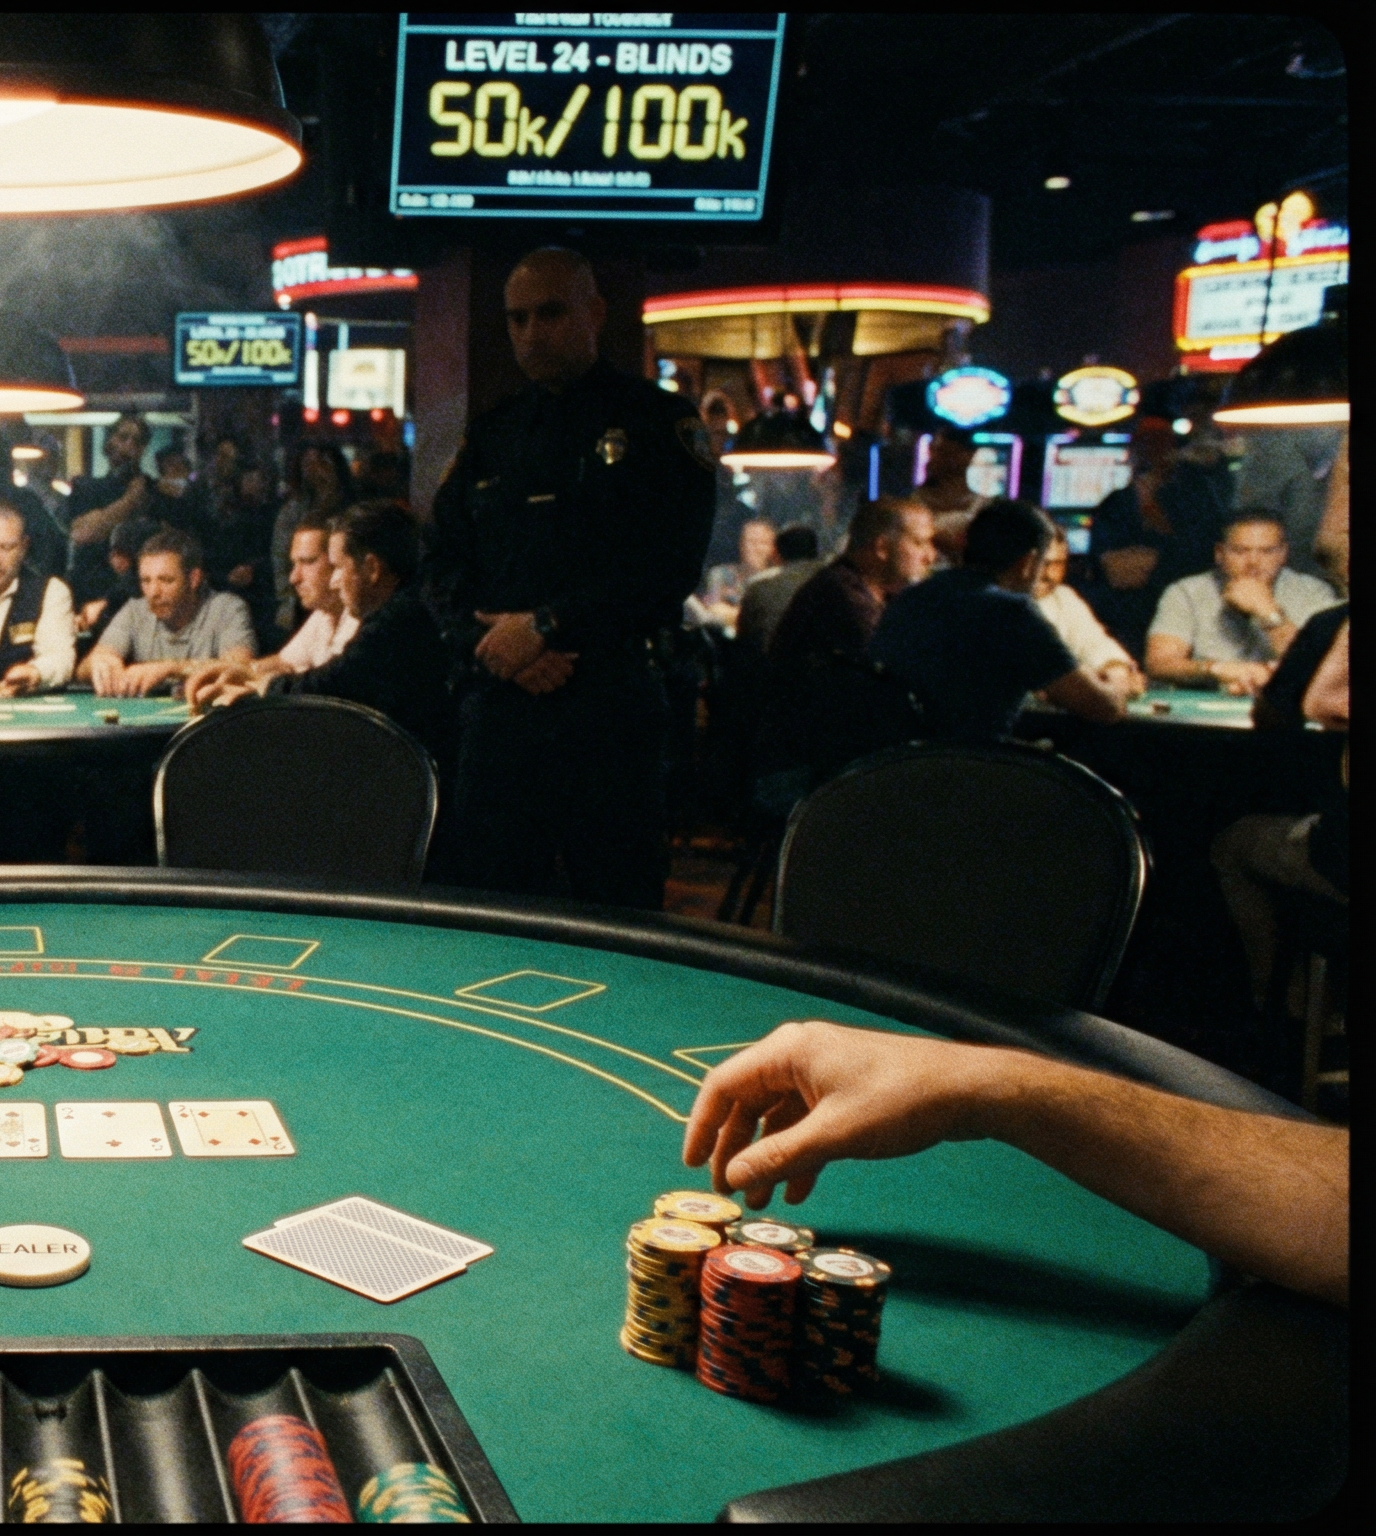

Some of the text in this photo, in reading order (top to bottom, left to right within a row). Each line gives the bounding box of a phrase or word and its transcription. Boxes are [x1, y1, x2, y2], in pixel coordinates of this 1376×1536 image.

[445, 40, 733, 75] LEVEL 24 - BLINDS
[429, 80, 749, 160] 50k/100k
